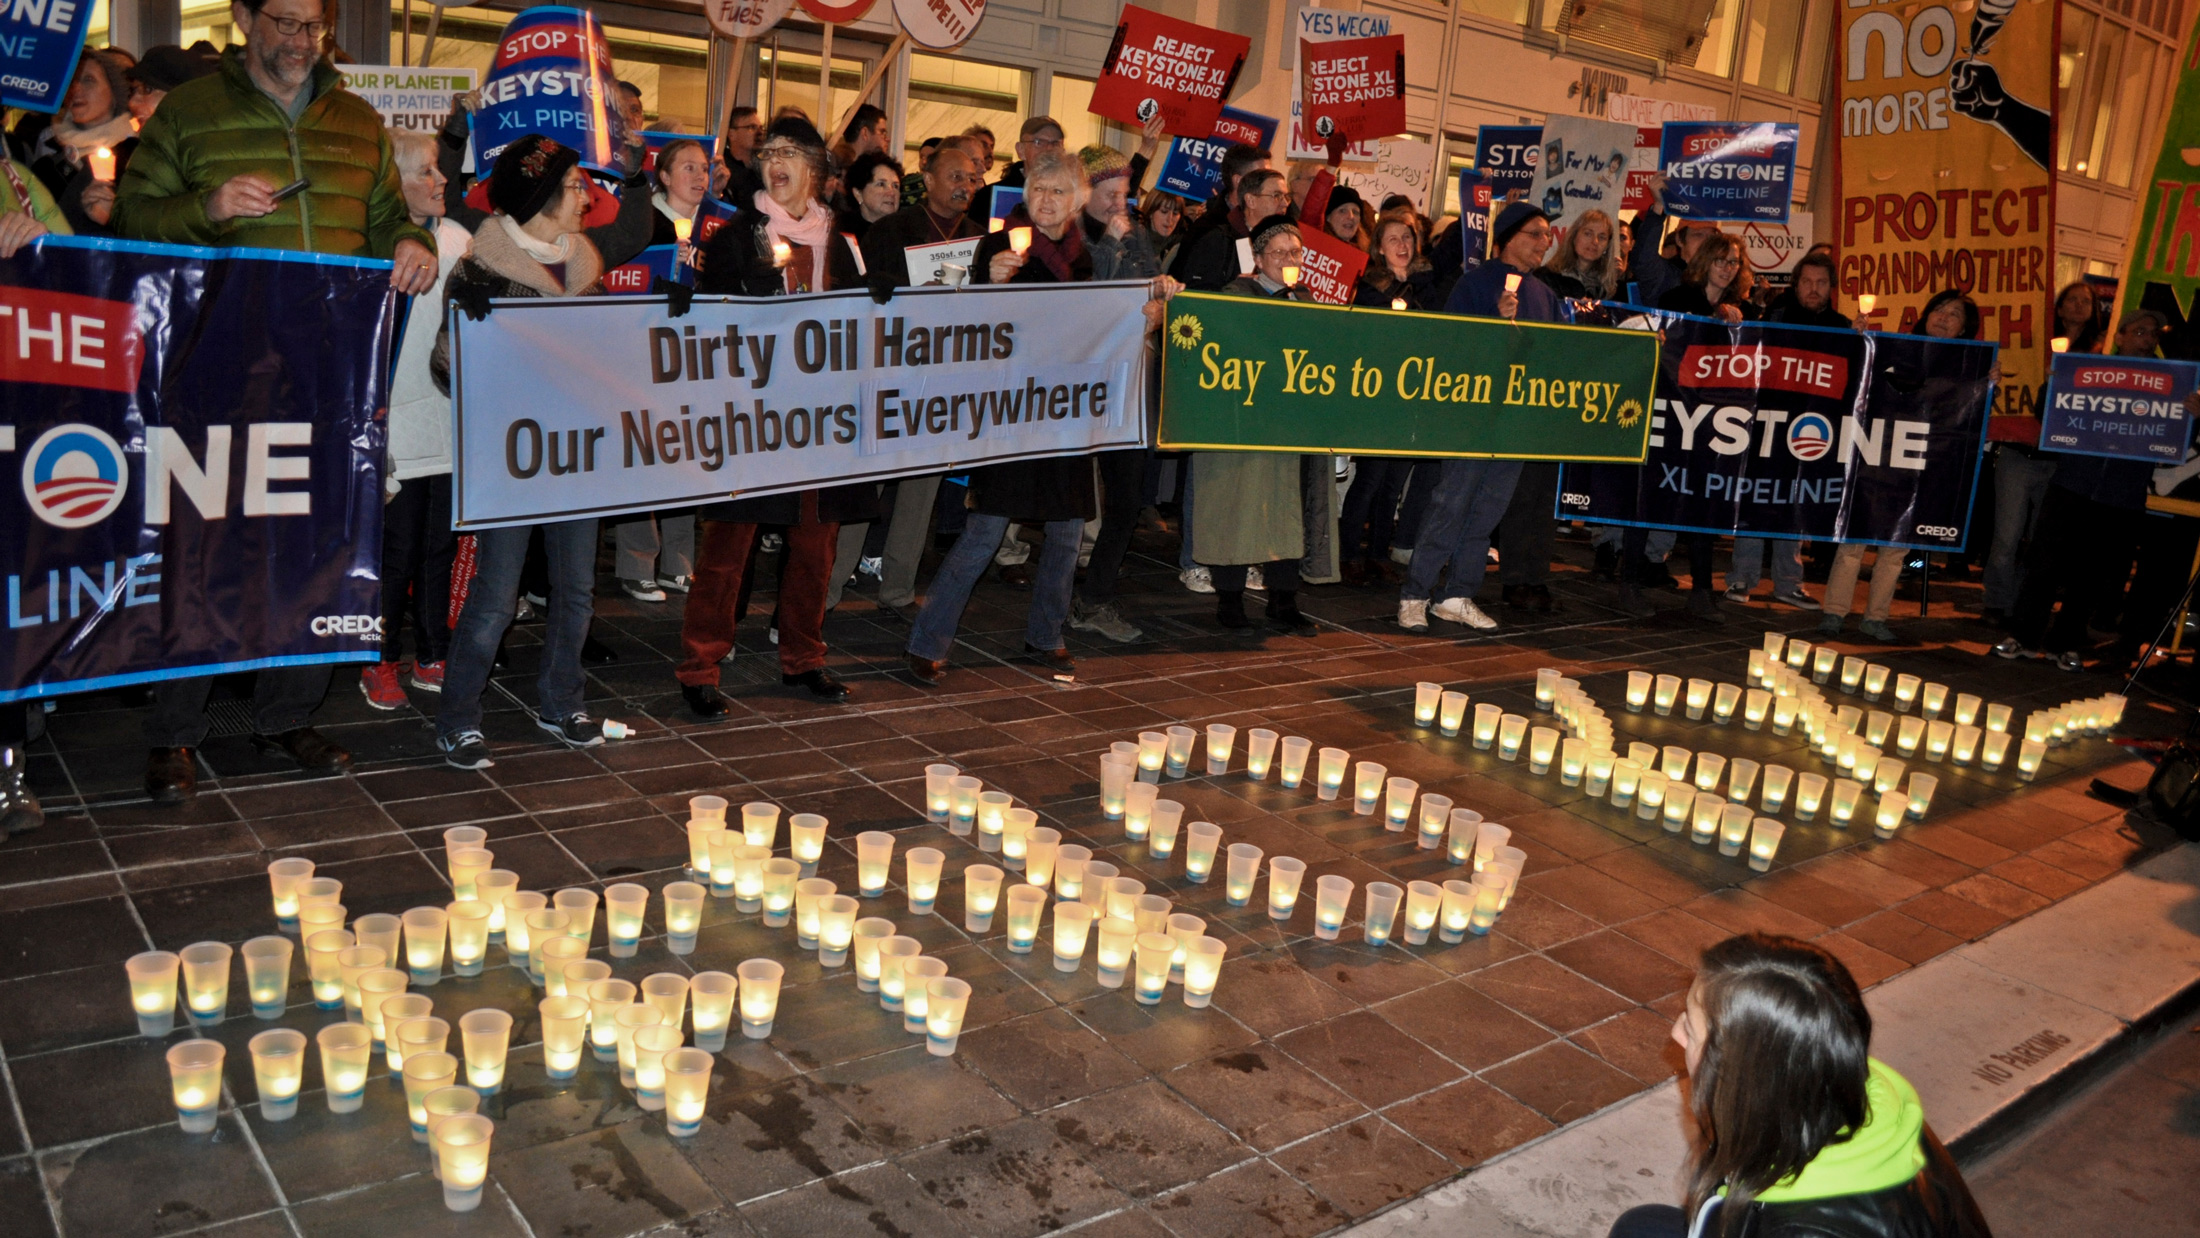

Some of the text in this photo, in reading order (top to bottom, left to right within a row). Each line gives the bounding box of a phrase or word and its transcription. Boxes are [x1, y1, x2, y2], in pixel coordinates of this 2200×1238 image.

[1301, 12, 1333, 34] YES
[506, 31, 607, 66] STOP THE
[1153, 35, 1215, 64] REJECT
[1120, 44, 1226, 86] KEYSTONE XL
[1311, 56, 1369, 75] REJECT
[0, 74, 49, 93] CREDO
[344, 74, 450, 90] OUR PLANET
[1115, 61, 1222, 99] NO TAR SANDS
[1312, 73, 1370, 92] STONE
[1375, 71, 1395, 85] XL
[1312, 85, 1395, 105] TAR SANDS
[1610, 94, 1657, 125] CLIMATE
[498, 111, 527, 130] XL
[1240, 126, 1258, 143] THE
[1690, 137, 1725, 152] STOP
[1184, 160, 1201, 177] XL
[1565, 150, 1582, 169] For
[1379, 160, 1421, 187] Energy
[1666, 162, 1786, 181] KEYSTONE
[1167, 177, 1191, 188] CREDO
[1351, 172, 1388, 197] Dirty
[1678, 183, 1770, 199] XL PIPELINE
[1755, 206, 1781, 214] CREDO
[1843, 185, 2048, 248] PROTECT
[610, 271, 642, 286] THE
[1840, 246, 2045, 301] GRANDMOTHER
[1334, 282, 1348, 302] XL
[649, 316, 1014, 389] Dirty Oil Harms
[1695, 354, 1833, 388] STOP THE
[2082, 371, 2164, 390] STOP THE
[1200, 341, 1621, 423] Say Yes to Clean Energy
[2055, 393, 2184, 419] KEYSTONE
[505, 376, 1107, 480] Our Neighbors Everywhere
[2066, 415, 2166, 437] XL PIPELINE
[2050, 434, 2077, 443] CREDO
[2148, 444, 2177, 453] CREDO
[0, 423, 312, 529] ONE
[1659, 462, 1842, 504] XL PIPELINE
[1561, 493, 1590, 505] CREDO
[1916, 525, 1958, 537] CREDO
[9, 554, 161, 629] LINE
[1972, 1029, 2071, 1086] NO PARKING
